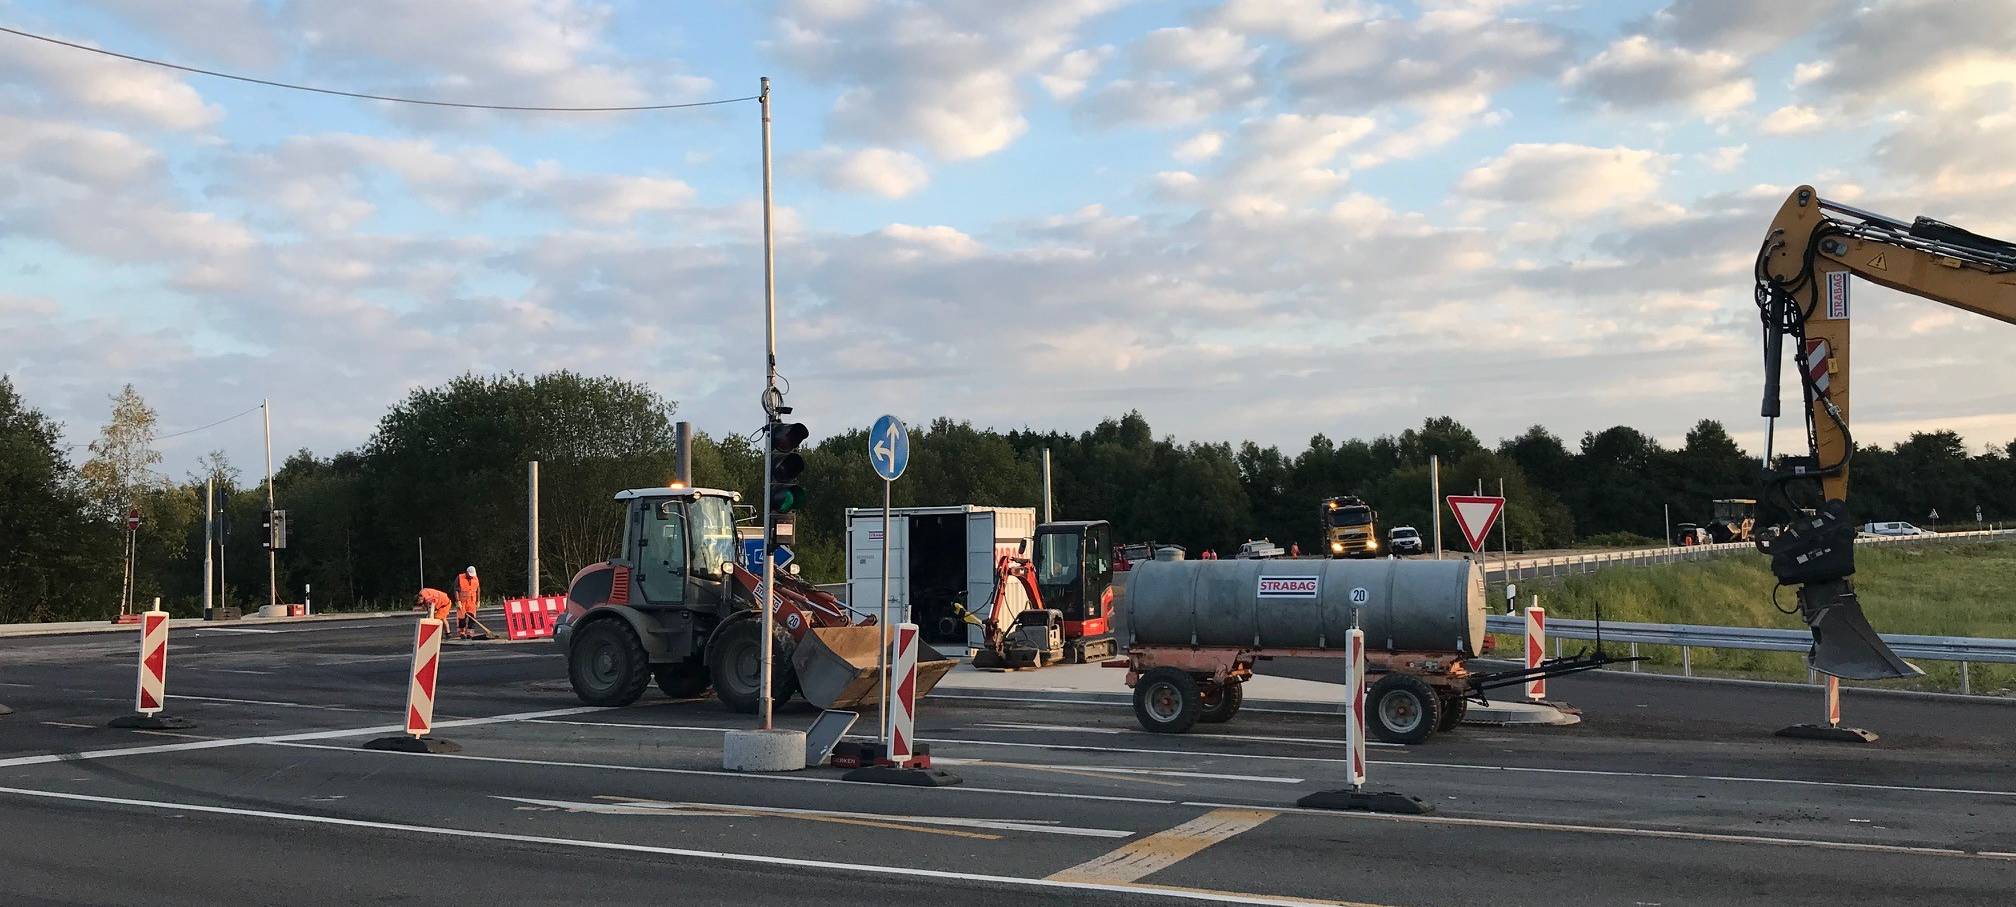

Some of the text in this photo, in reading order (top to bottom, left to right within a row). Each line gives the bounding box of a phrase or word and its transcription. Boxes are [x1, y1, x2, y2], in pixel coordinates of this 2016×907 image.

[1833, 273, 1843, 318] STRABAG
[1260, 581, 1316, 591] STRABAG
[1353, 589, 1366, 602] 20
[788, 615, 799, 628] 20
